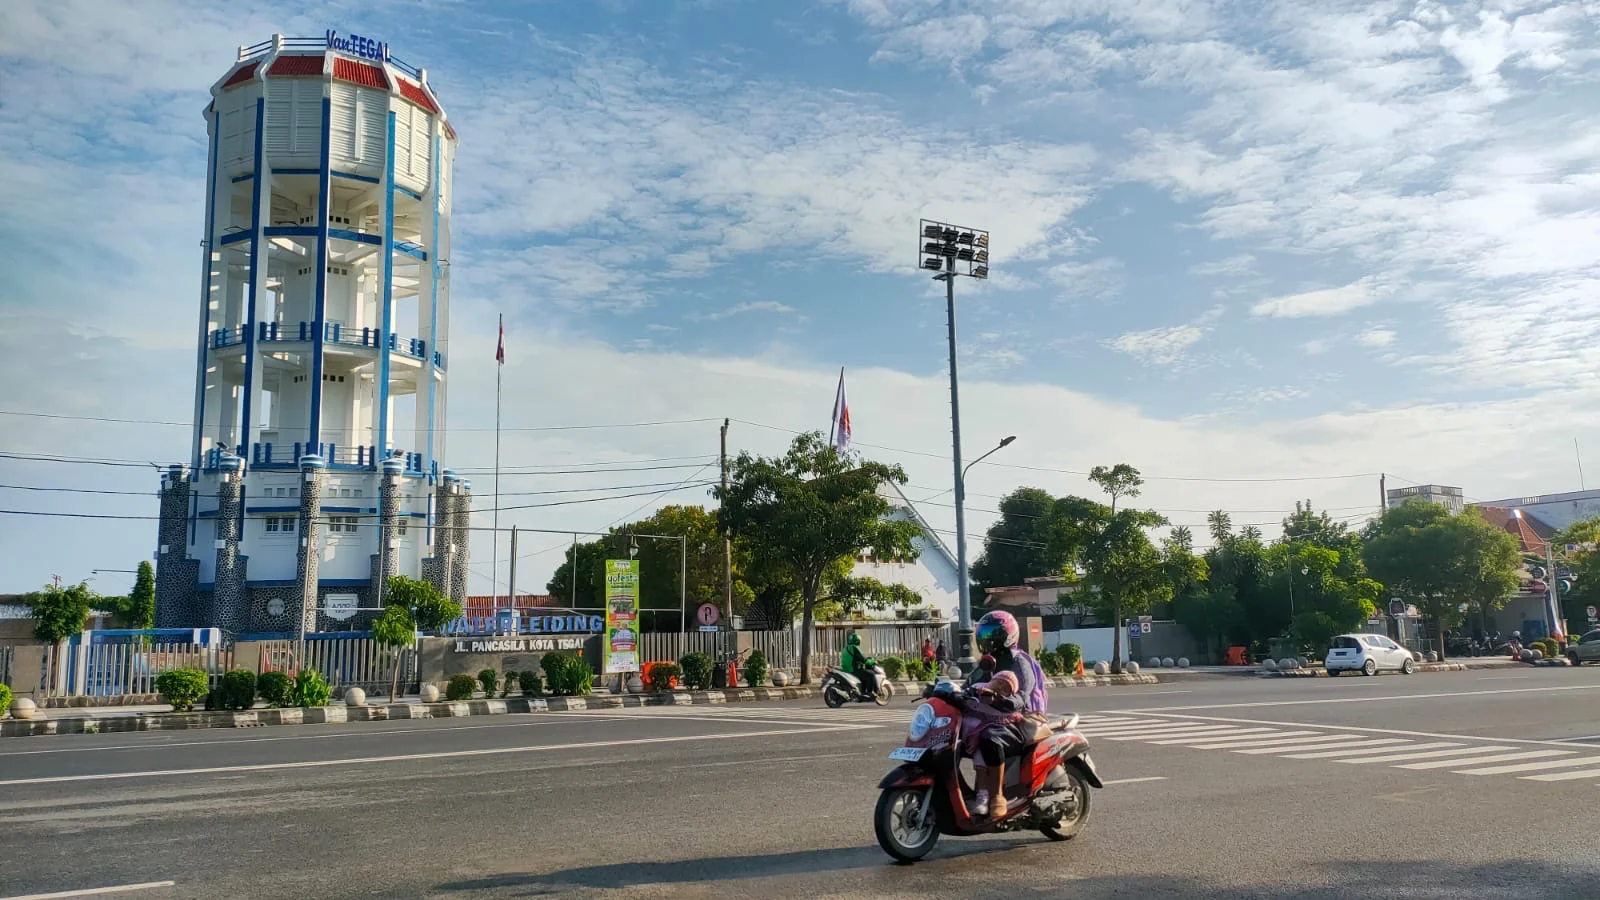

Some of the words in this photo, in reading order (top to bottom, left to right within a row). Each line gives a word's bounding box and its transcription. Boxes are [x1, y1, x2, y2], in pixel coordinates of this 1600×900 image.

[438, 615, 604, 635] WATERLEIDING
[471, 640, 526, 652] PANCASILA
[529, 639, 554, 651] KOTA
